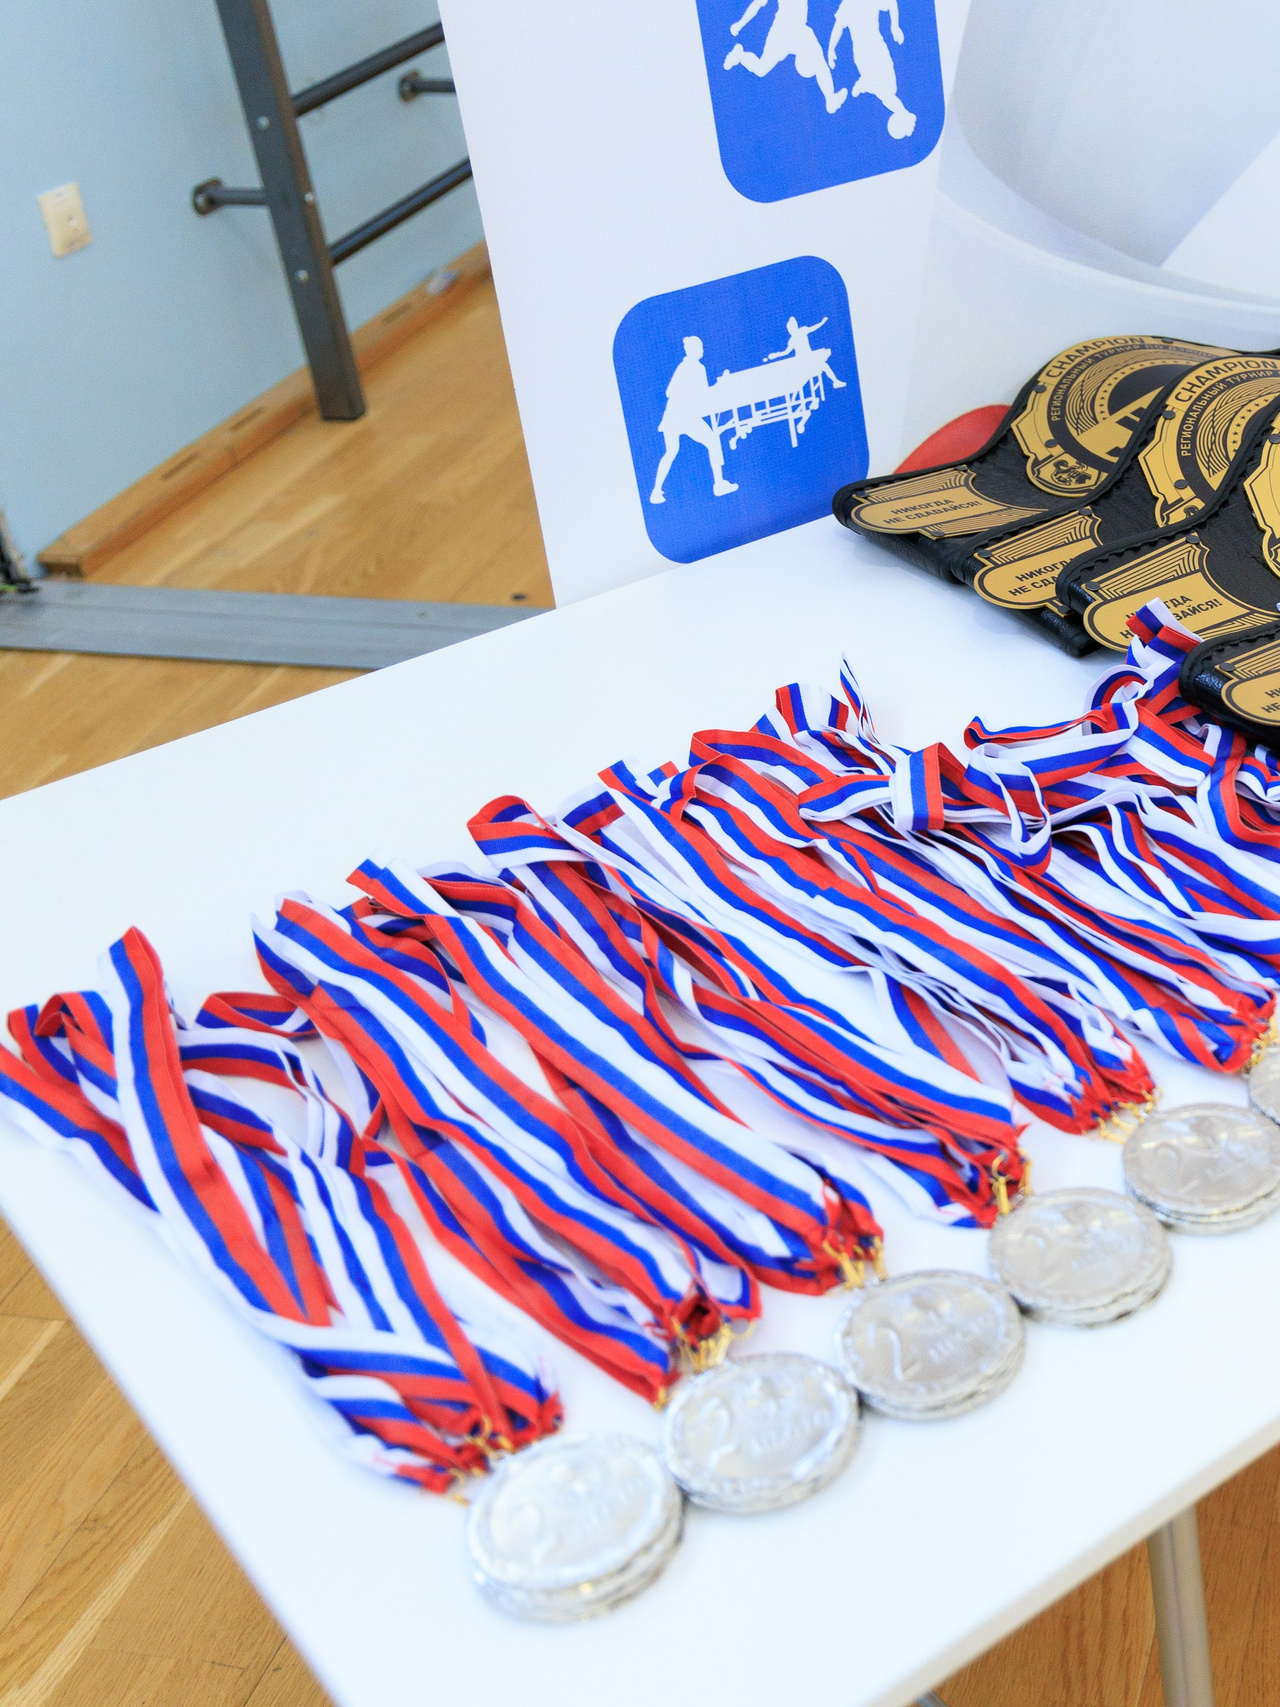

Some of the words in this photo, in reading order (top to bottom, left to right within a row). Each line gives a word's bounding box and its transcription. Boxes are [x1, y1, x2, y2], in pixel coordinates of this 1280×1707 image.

[1046, 336, 1146, 378] CHAMPION
[1051, 356, 1095, 422] РЕГИОНАЛЬНЫЙ
[1174, 360, 1279, 404] CHAMPION
[1181, 383, 1227, 458] РЕГИОНАЛЬНЫЙ
[1226, 370, 1274, 386] ТУРНИР
[883, 516, 904, 526] НЕ
[904, 500, 983, 522] СДАВАЙСЯ!
[891, 499, 955, 515] НИКОГДА
[1015, 557, 1074, 582] НИКОГД
[1008, 585, 1032, 597] НЕ
